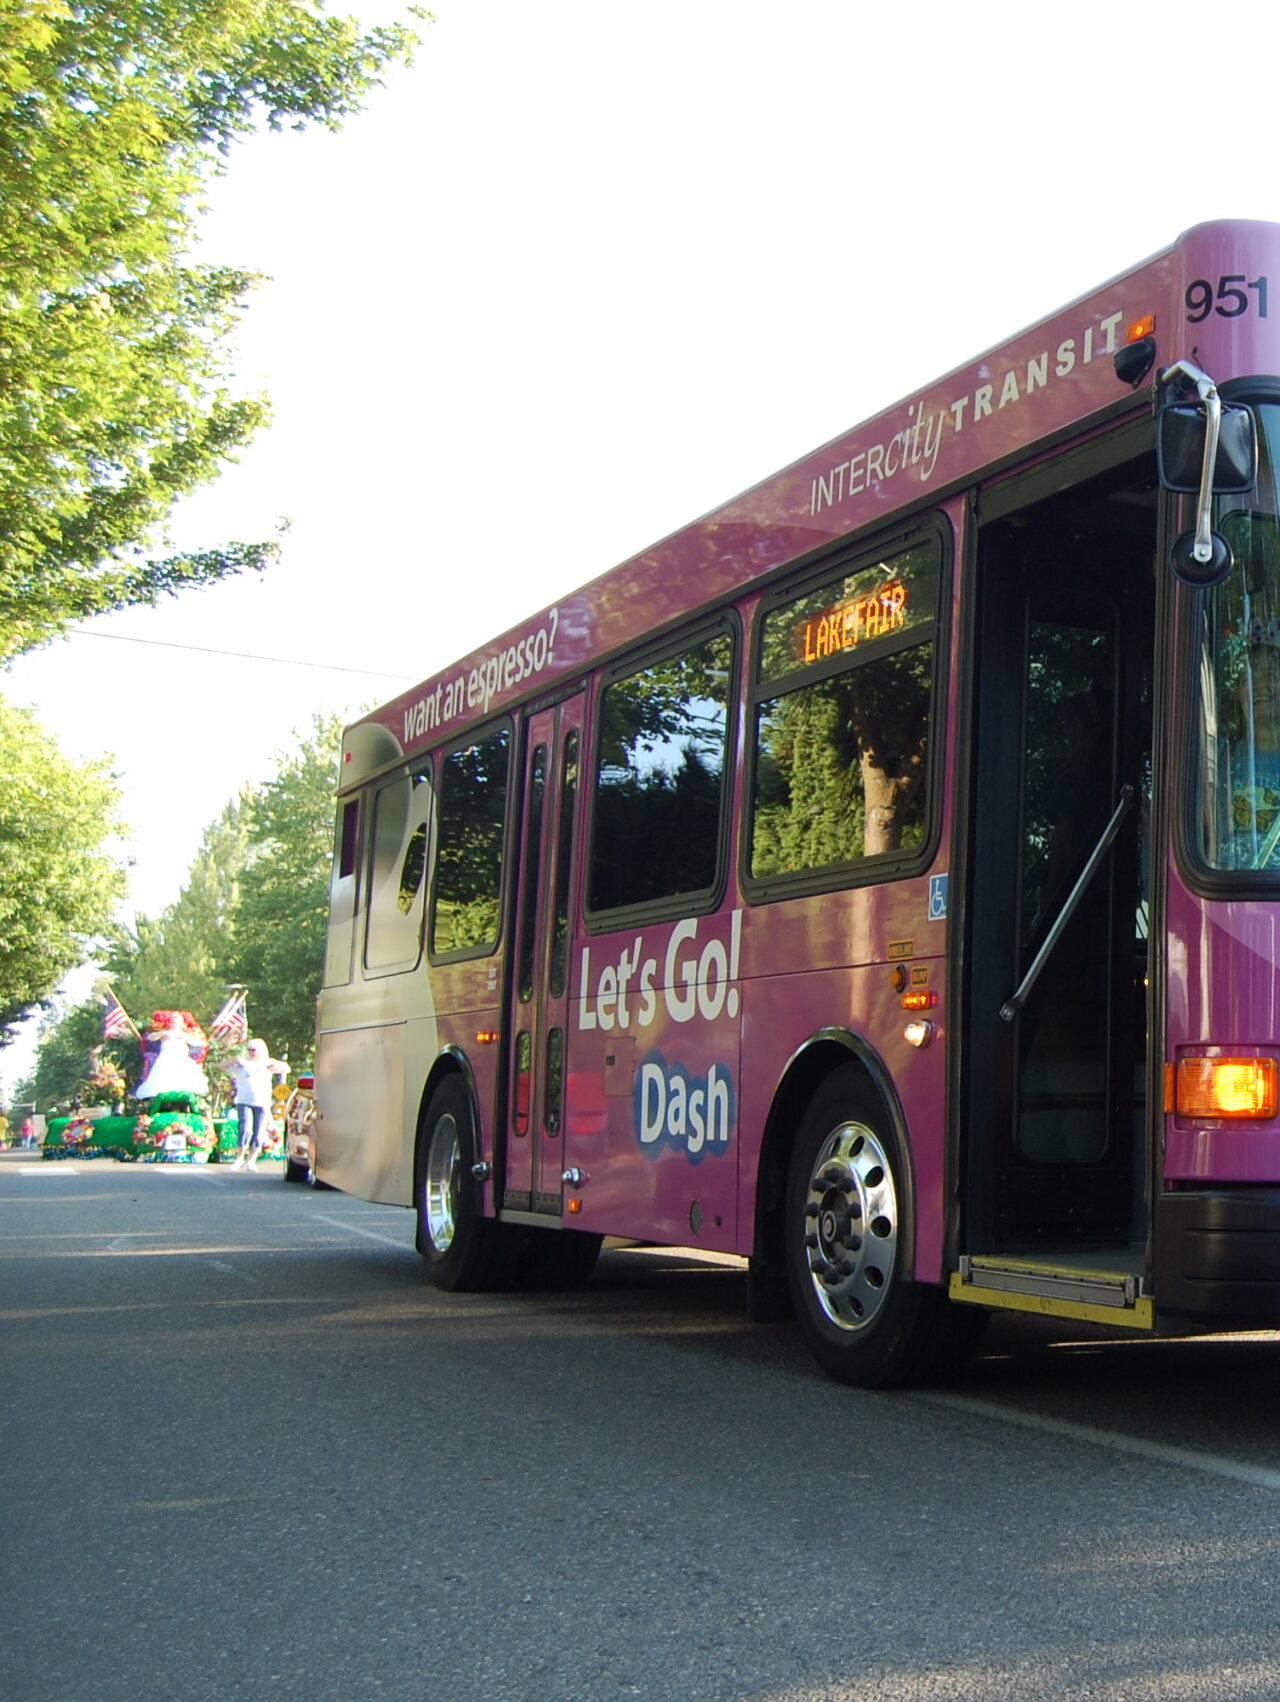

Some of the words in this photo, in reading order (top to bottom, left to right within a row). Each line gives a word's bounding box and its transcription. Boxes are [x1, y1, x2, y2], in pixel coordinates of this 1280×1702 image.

[1185, 274, 1267, 323] 951
[811, 400, 947, 516] INTERcity
[951, 311, 1123, 432] TRANSIT
[404, 681, 443, 743] want
[443, 675, 465, 722] an
[467, 607, 559, 714] espresso?
[805, 585, 906, 663] LAKEFAIR
[579, 936, 657, 1030] Let's
[664, 909, 742, 1023] Go!
[640, 1063, 729, 1153] Dash
